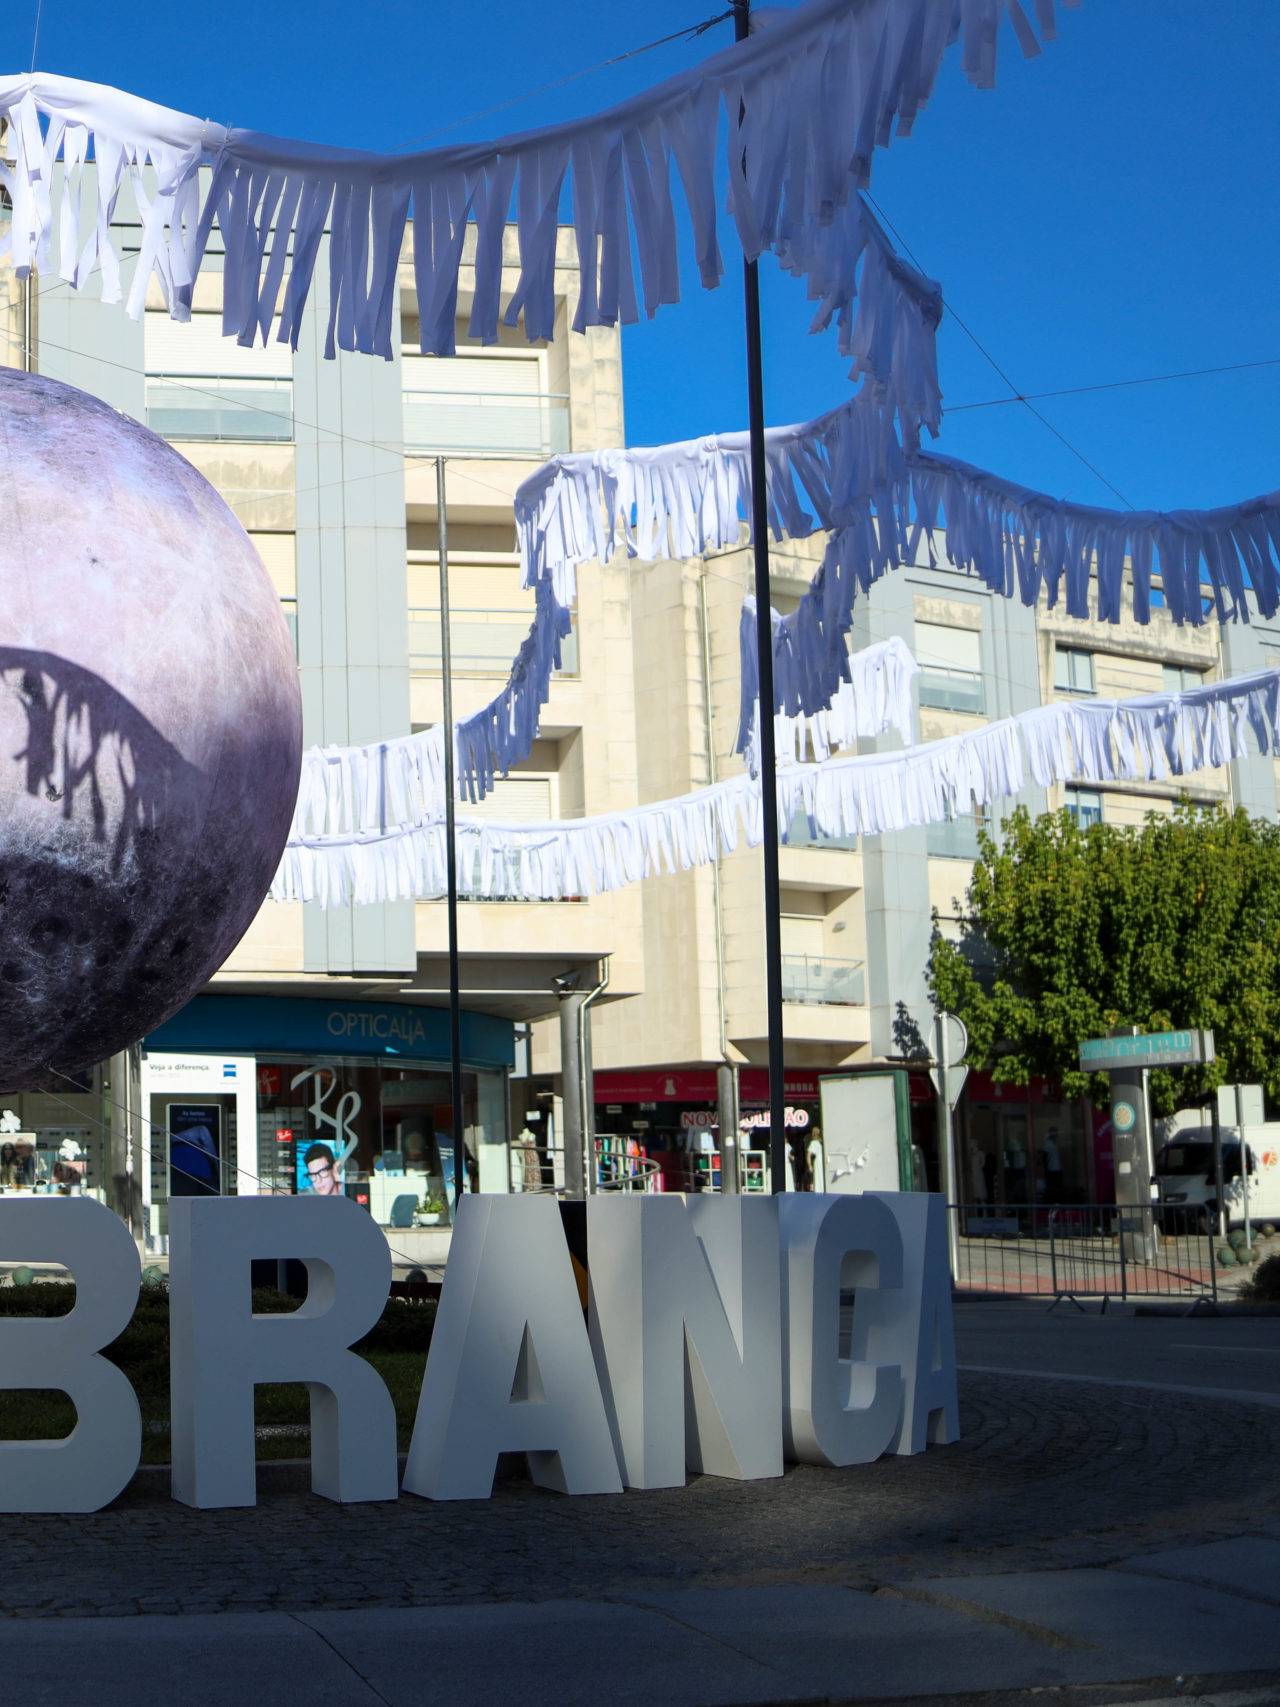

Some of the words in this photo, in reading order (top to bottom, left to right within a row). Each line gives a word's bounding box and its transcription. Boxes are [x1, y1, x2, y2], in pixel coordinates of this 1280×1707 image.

[149, 1063, 166, 1072] Veja
[174, 1063, 210, 1072] diferença
[681, 1110, 719, 1128] NOV
